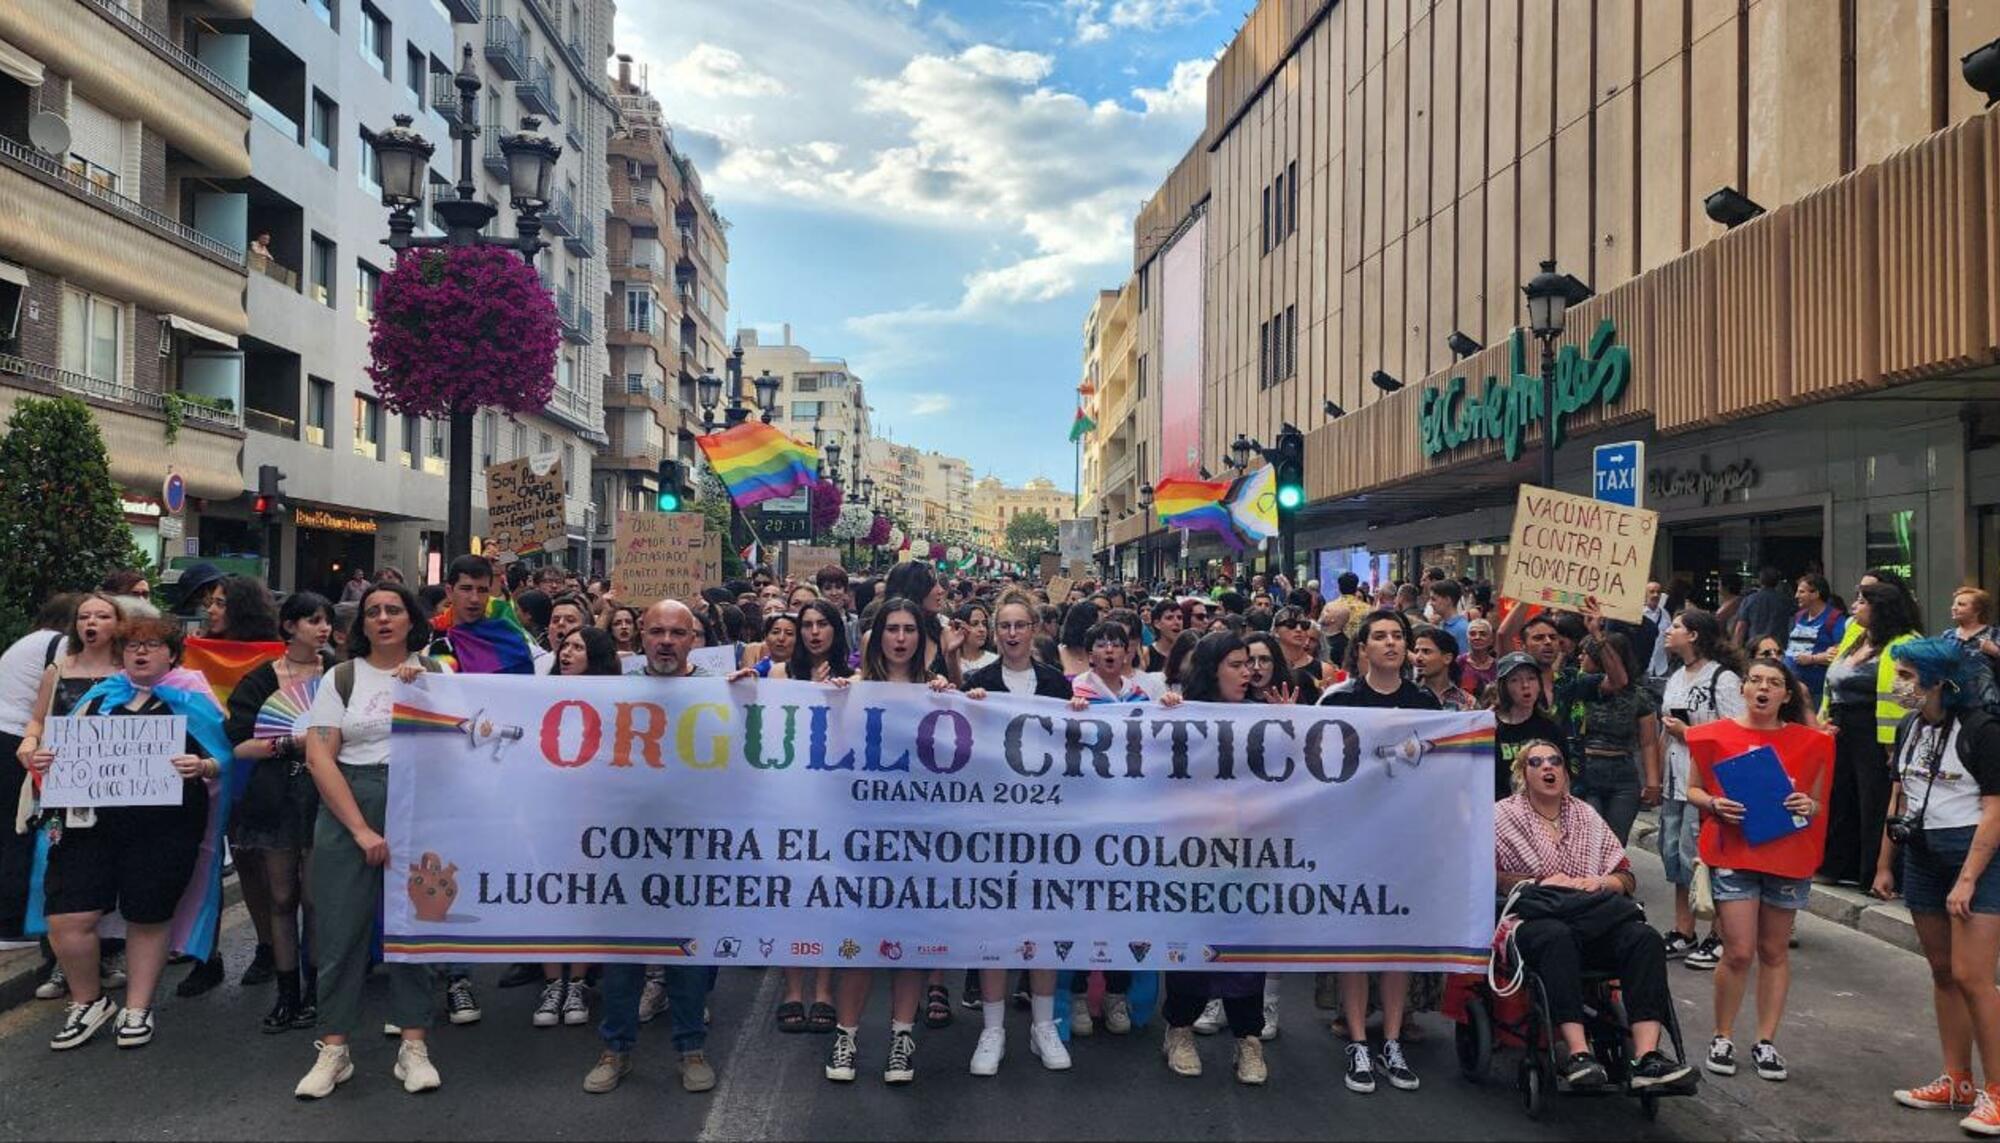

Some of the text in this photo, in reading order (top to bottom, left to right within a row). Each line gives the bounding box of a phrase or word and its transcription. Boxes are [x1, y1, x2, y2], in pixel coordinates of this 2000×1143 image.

[491, 467, 536, 493] Soy la
[1597, 468, 1635, 491] TAXI
[1522, 524, 1638, 568] CONTRA LA
[1514, 551, 1626, 596] HOMOFOBÍA
[539, 699, 1362, 784] ORGULLO CRÍTICO
[851, 779, 1063, 805] GRANADA 2024
[580, 827, 1317, 872] CONTRA EL GENOCIDIO COLONIAL,
[478, 870, 1410, 916] LUCHA QUEER ANDALUSÍ INTERSECCIONAL.
